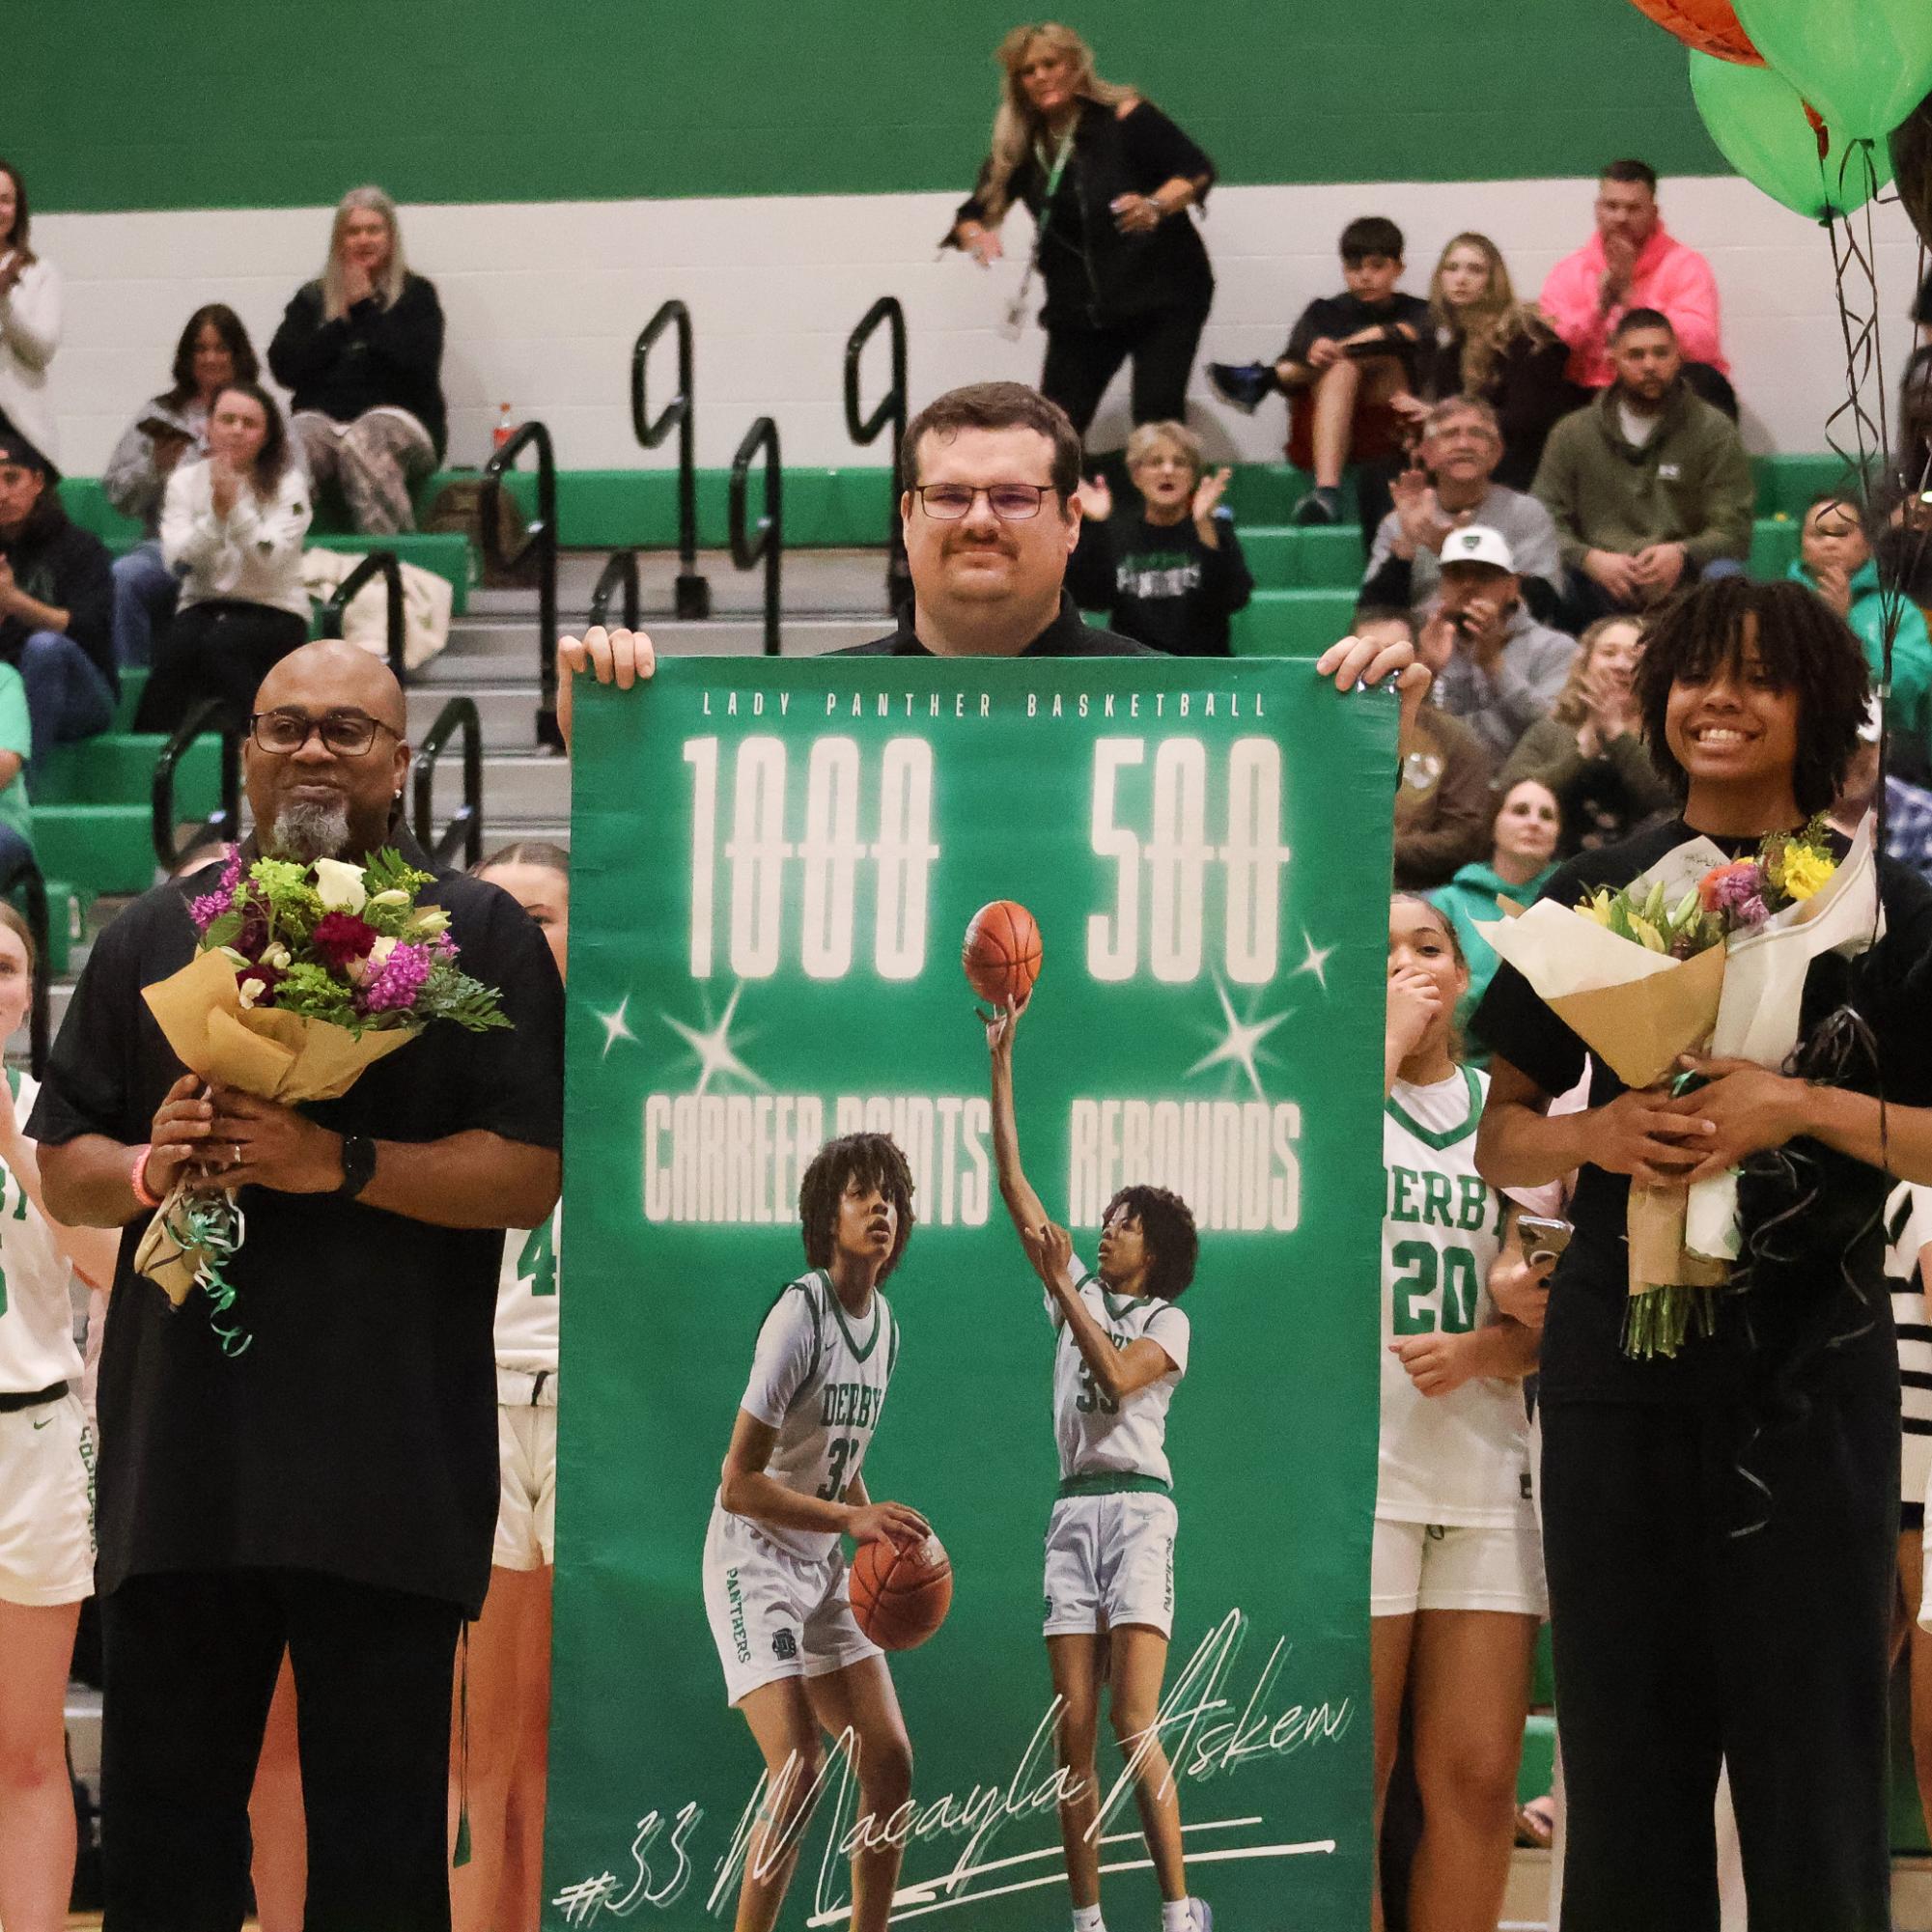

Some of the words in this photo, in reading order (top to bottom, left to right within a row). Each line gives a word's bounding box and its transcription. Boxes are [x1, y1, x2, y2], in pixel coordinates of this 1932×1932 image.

[703, 691, 789, 715] LADY
[826, 692, 990, 717] PANTHER
[1026, 693, 1264, 717] BASKETBALL
[684, 736, 939, 980] 1000
[1087, 738, 1290, 984] 500
[836, 1097, 991, 1226] NTS
[1069, 1099, 1301, 1231] REBOUNDS
[1382, 1164, 1502, 1236] ERB
[1391, 1240, 1478, 1335] 20
[820, 1383, 882, 1430] DERBY
[726, 1566, 751, 1664] PANTHERS
[552, 1801, 703, 1927] #33
[707, 1693, 1091, 1918] Macayla
